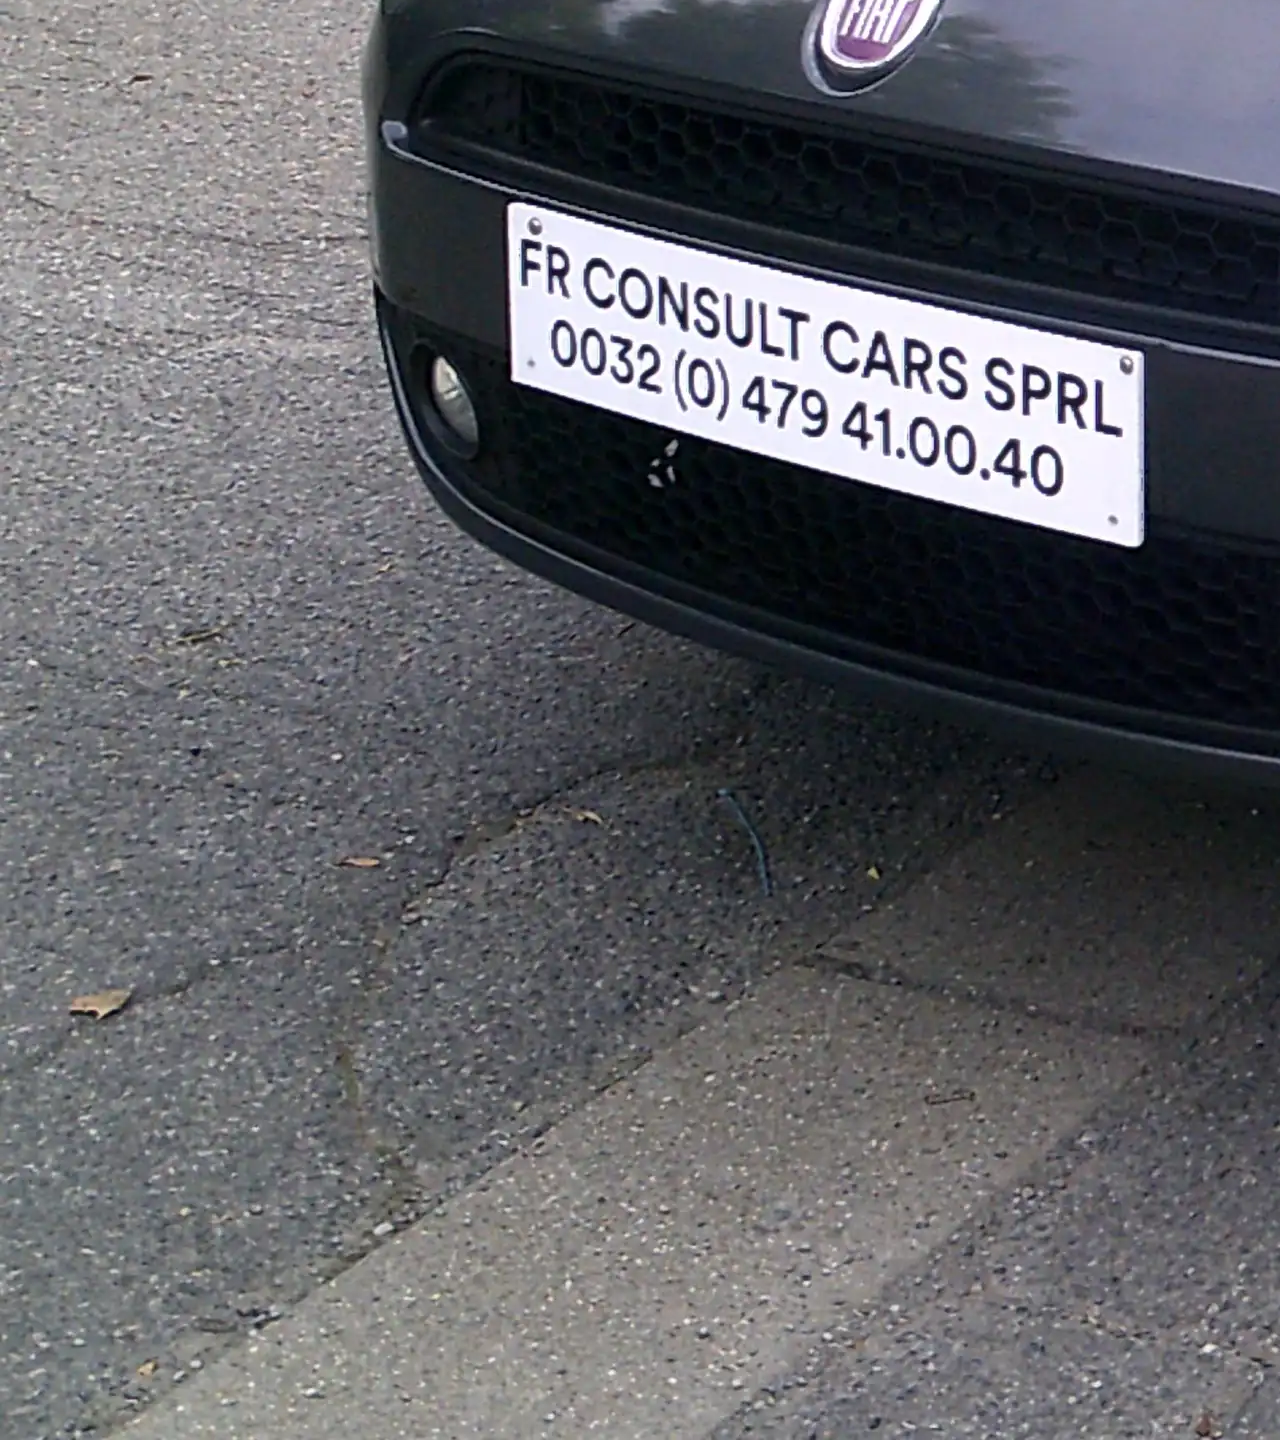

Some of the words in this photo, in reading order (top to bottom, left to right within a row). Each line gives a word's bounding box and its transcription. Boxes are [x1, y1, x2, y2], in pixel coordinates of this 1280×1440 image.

[520, 238, 571, 299] FR
[583, 257, 811, 361] CONSULT
[822, 320, 968, 401] CARS
[984, 357, 1123, 438] SPRL
[550, 319, 663, 394] 0032
[674, 348, 730, 422] (0)
[741, 375, 829, 438] 479
[842, 401, 1064, 497] 41.00.40
